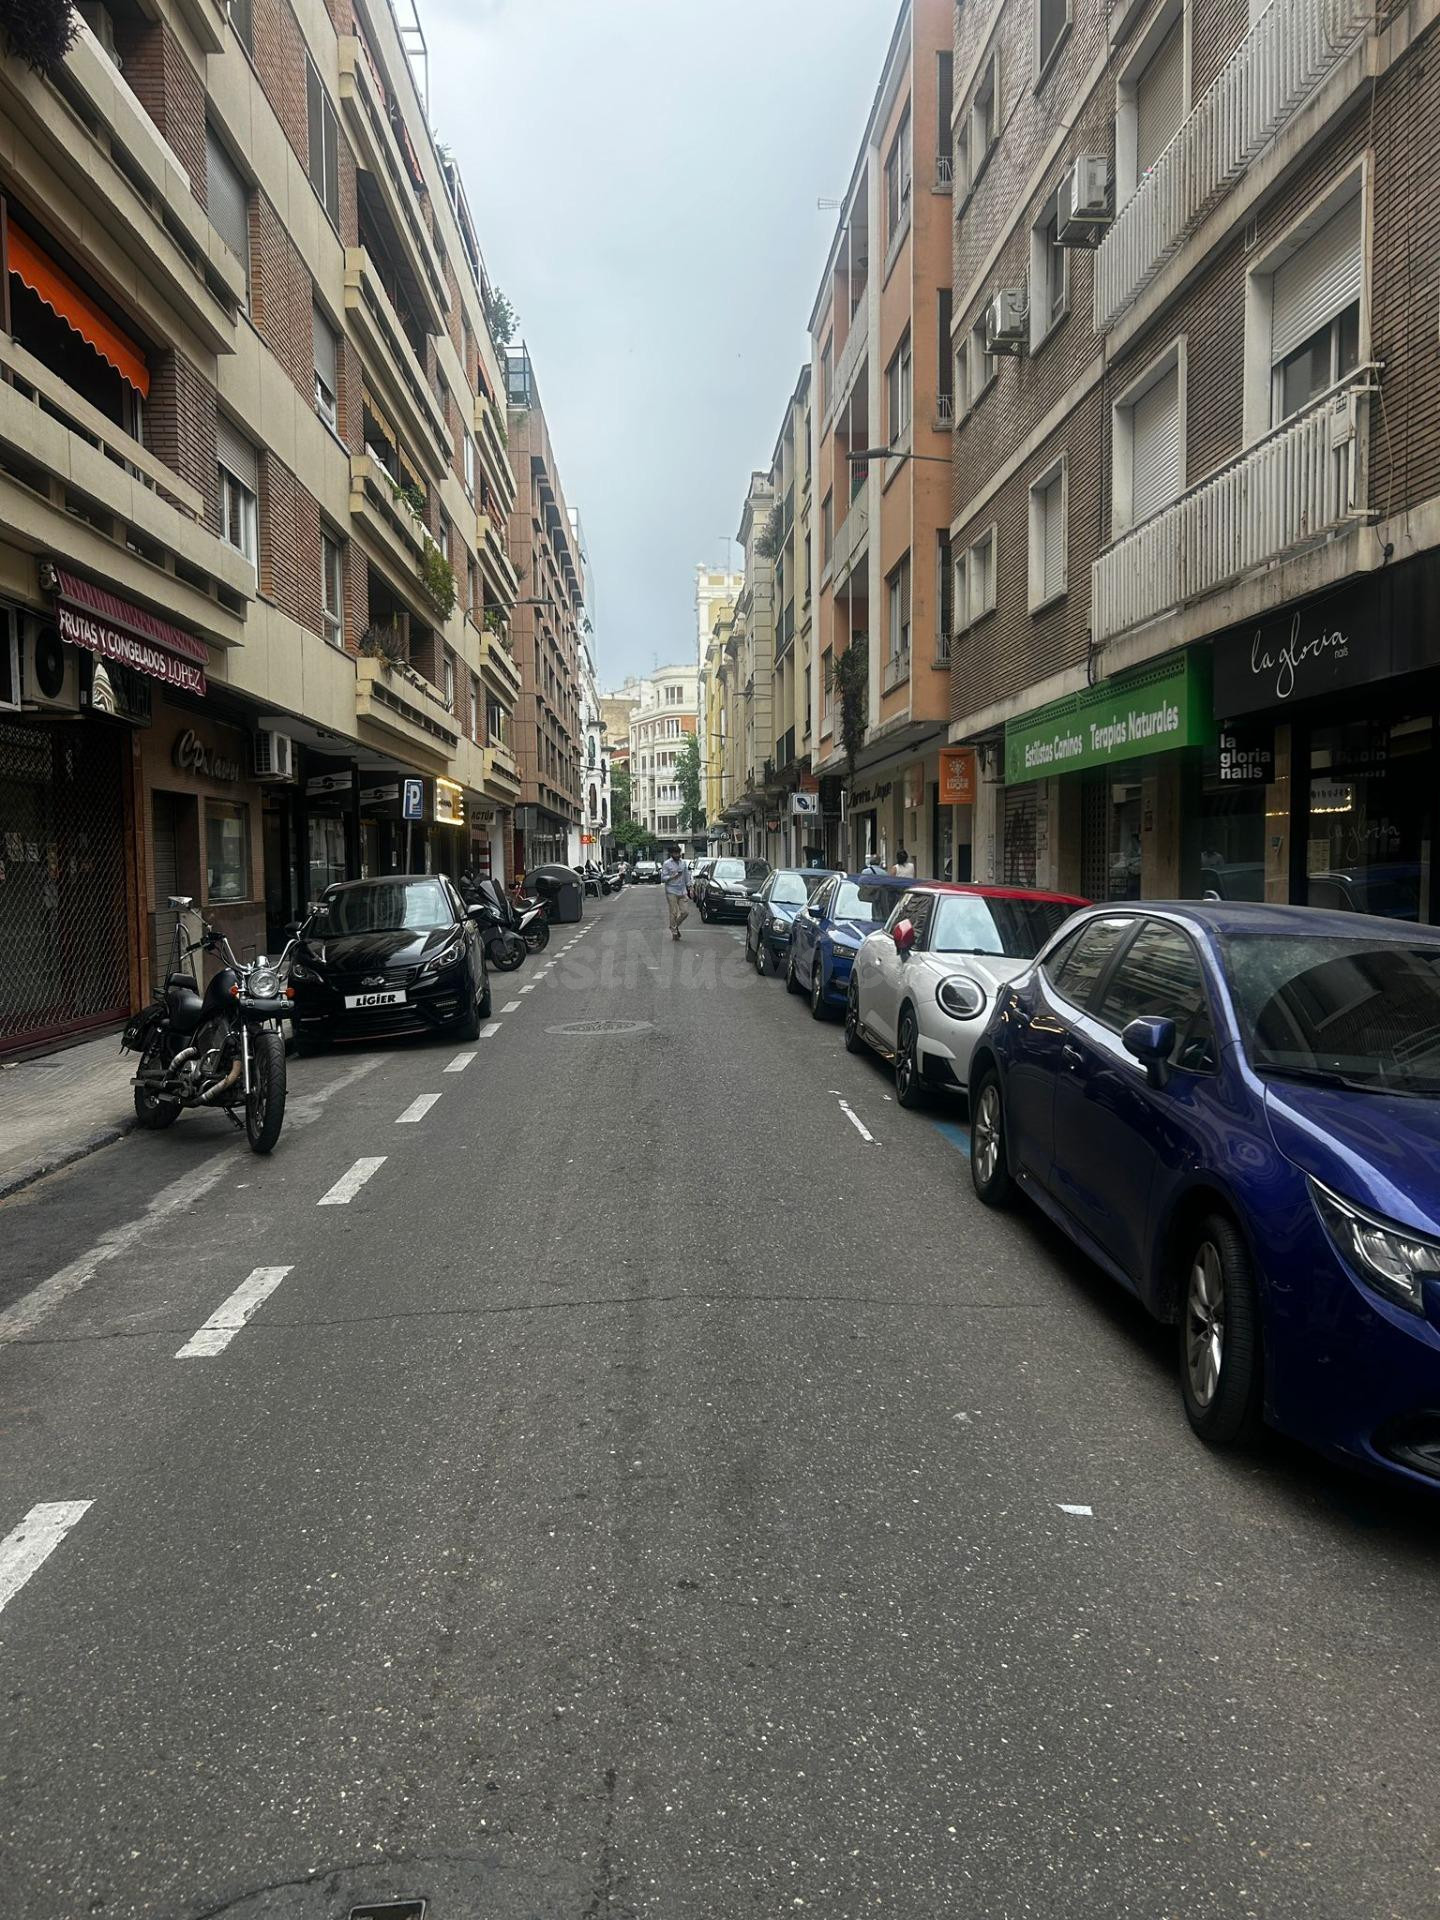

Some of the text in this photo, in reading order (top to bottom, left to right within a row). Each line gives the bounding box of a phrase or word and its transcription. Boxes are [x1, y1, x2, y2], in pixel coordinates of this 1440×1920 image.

[59, 609, 98, 644] FRUTAS
[99, 629, 108, 647] Y
[107, 630, 166, 673] CONGELADOS
[1251, 612, 1348, 699] la gloria
[1025, 700, 1178, 768] Estilistas Caninos Terapias Naturales
[1220, 733, 1236, 748] la
[1220, 748, 1271, 769] gloria
[1220, 764, 1263, 779] nails
[408, 785, 420, 814] P
